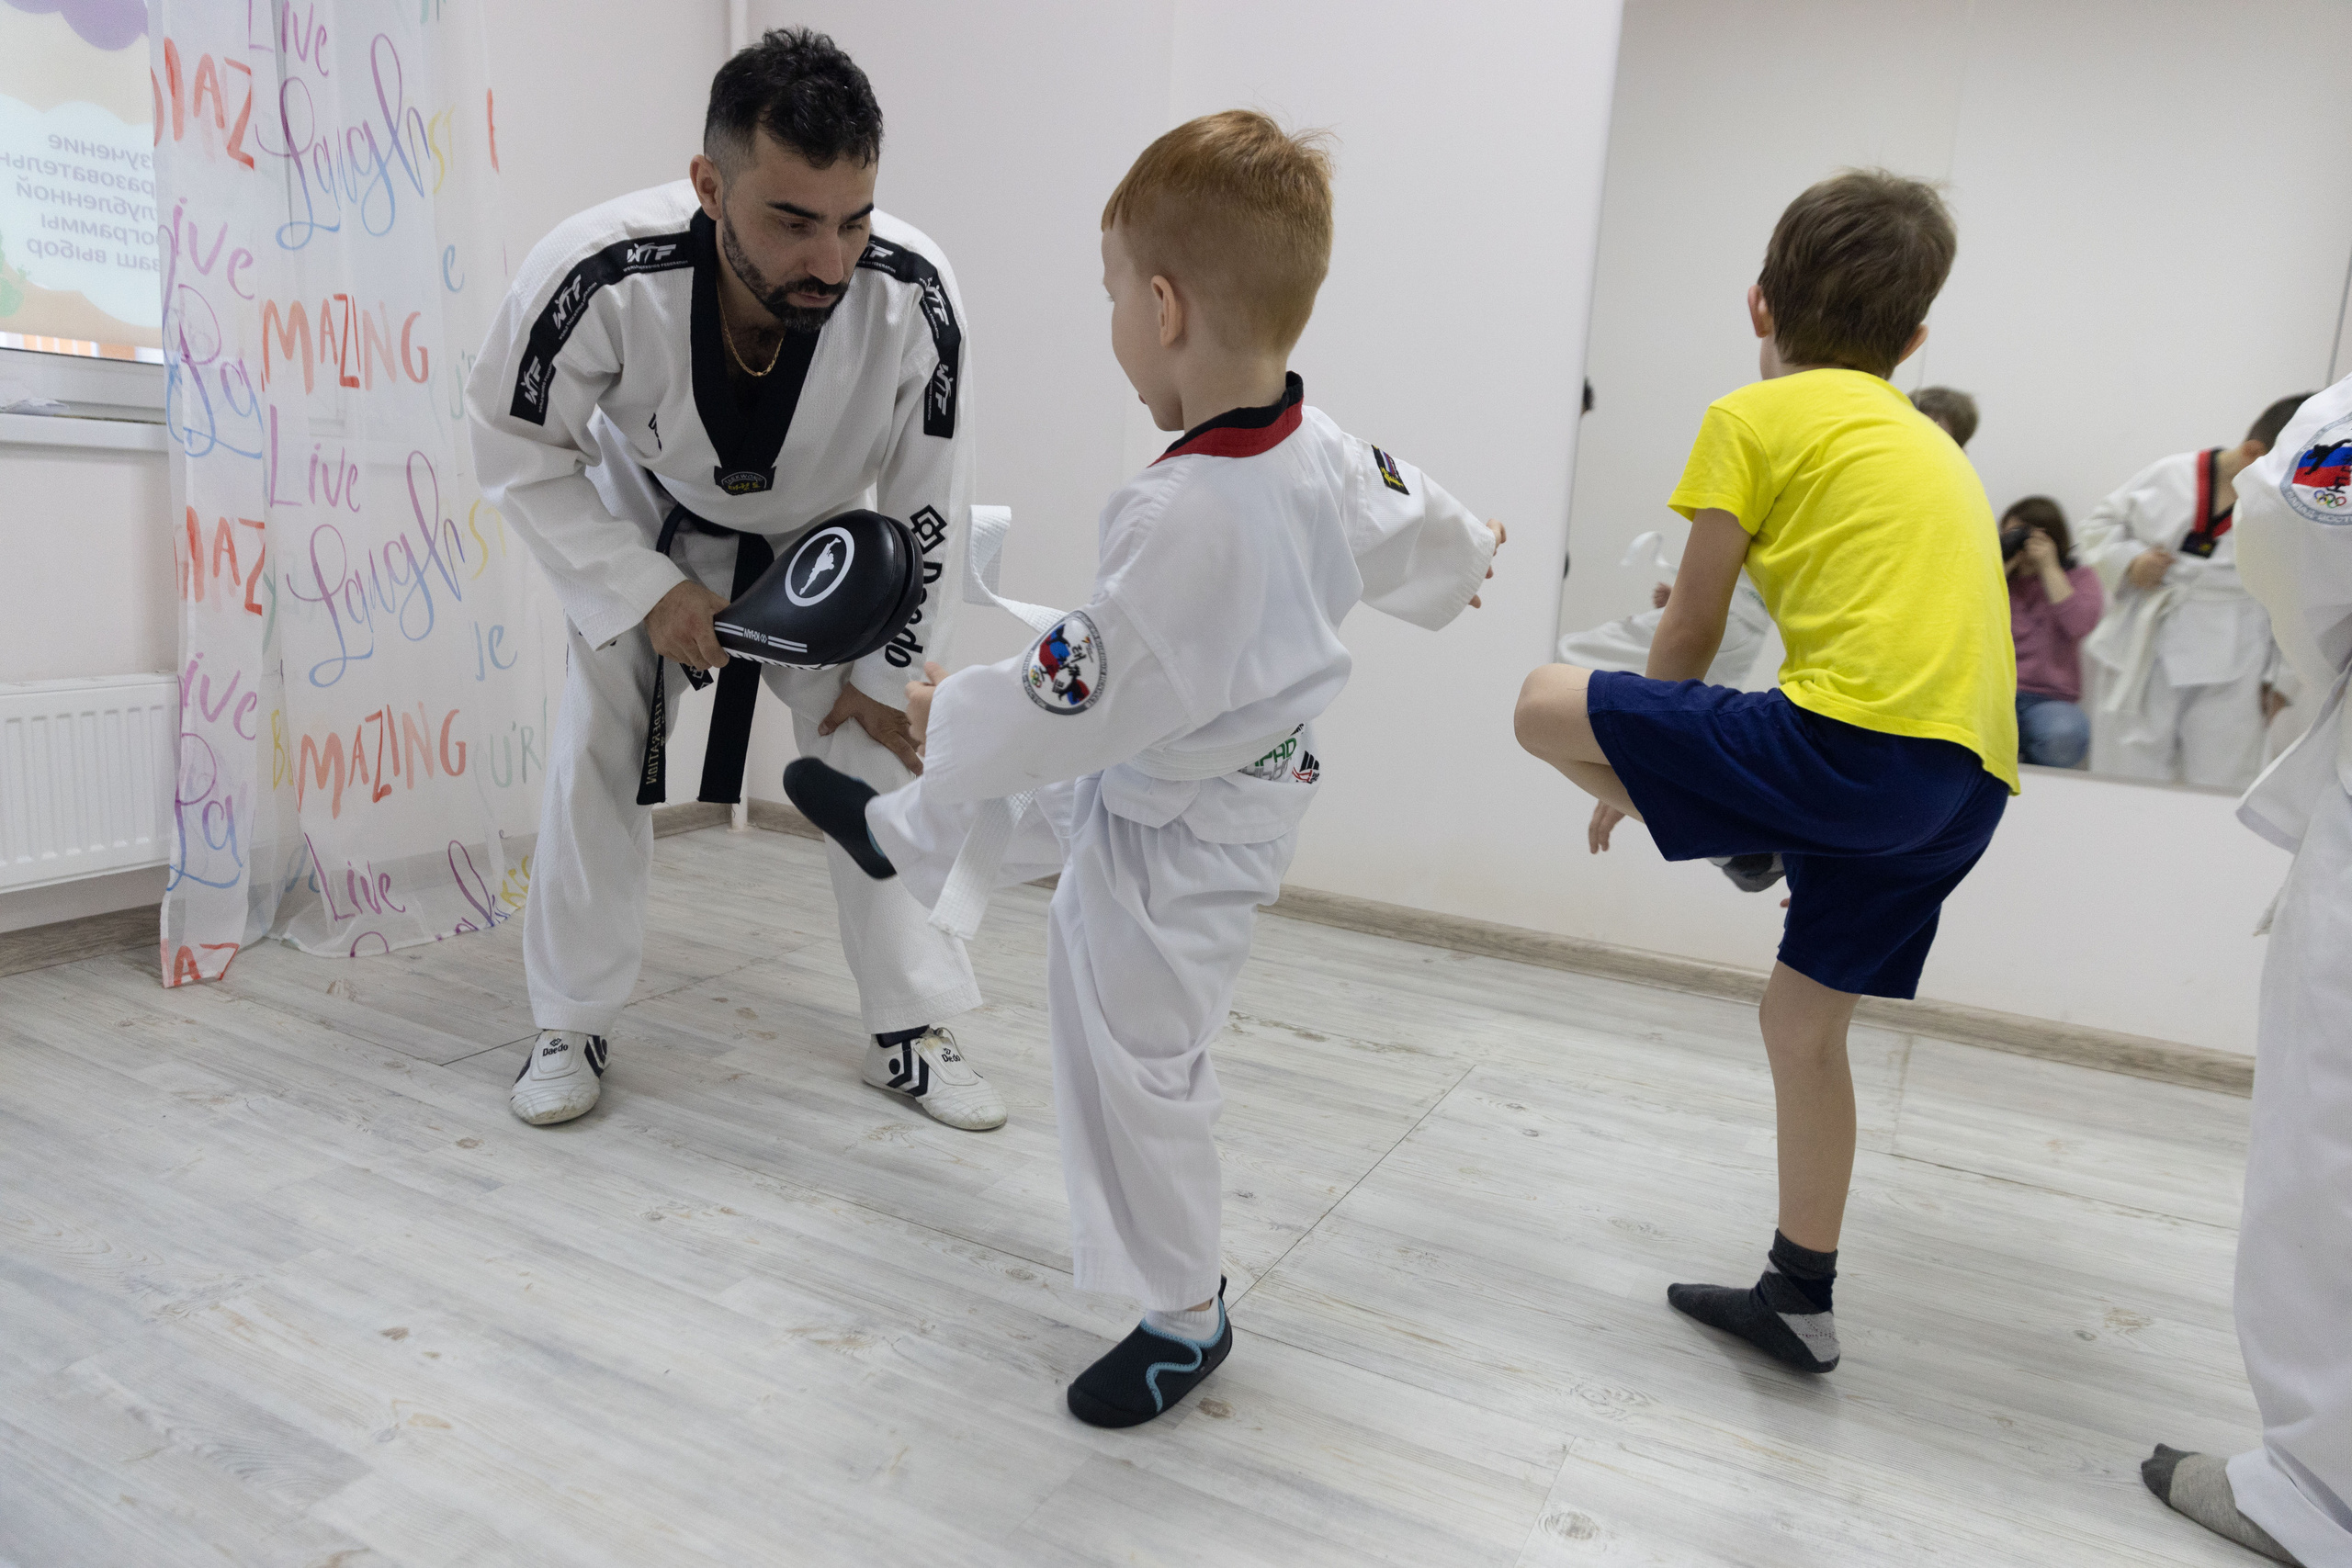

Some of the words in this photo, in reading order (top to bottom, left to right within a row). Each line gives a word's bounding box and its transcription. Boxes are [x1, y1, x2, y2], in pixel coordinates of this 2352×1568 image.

[627, 243, 677, 264] WTF
[864, 241, 894, 258] TF
[552, 274, 582, 330] WTF
[261, 293, 429, 396] MAZING
[521, 355, 541, 405] WTF
[934, 363, 954, 416] WTF
[269, 404, 361, 513] Live
[885, 561, 943, 668] Ddo
[296, 701, 467, 820] MAZING
[304, 832, 406, 921] Live
[543, 1043, 569, 1056] Daedo
